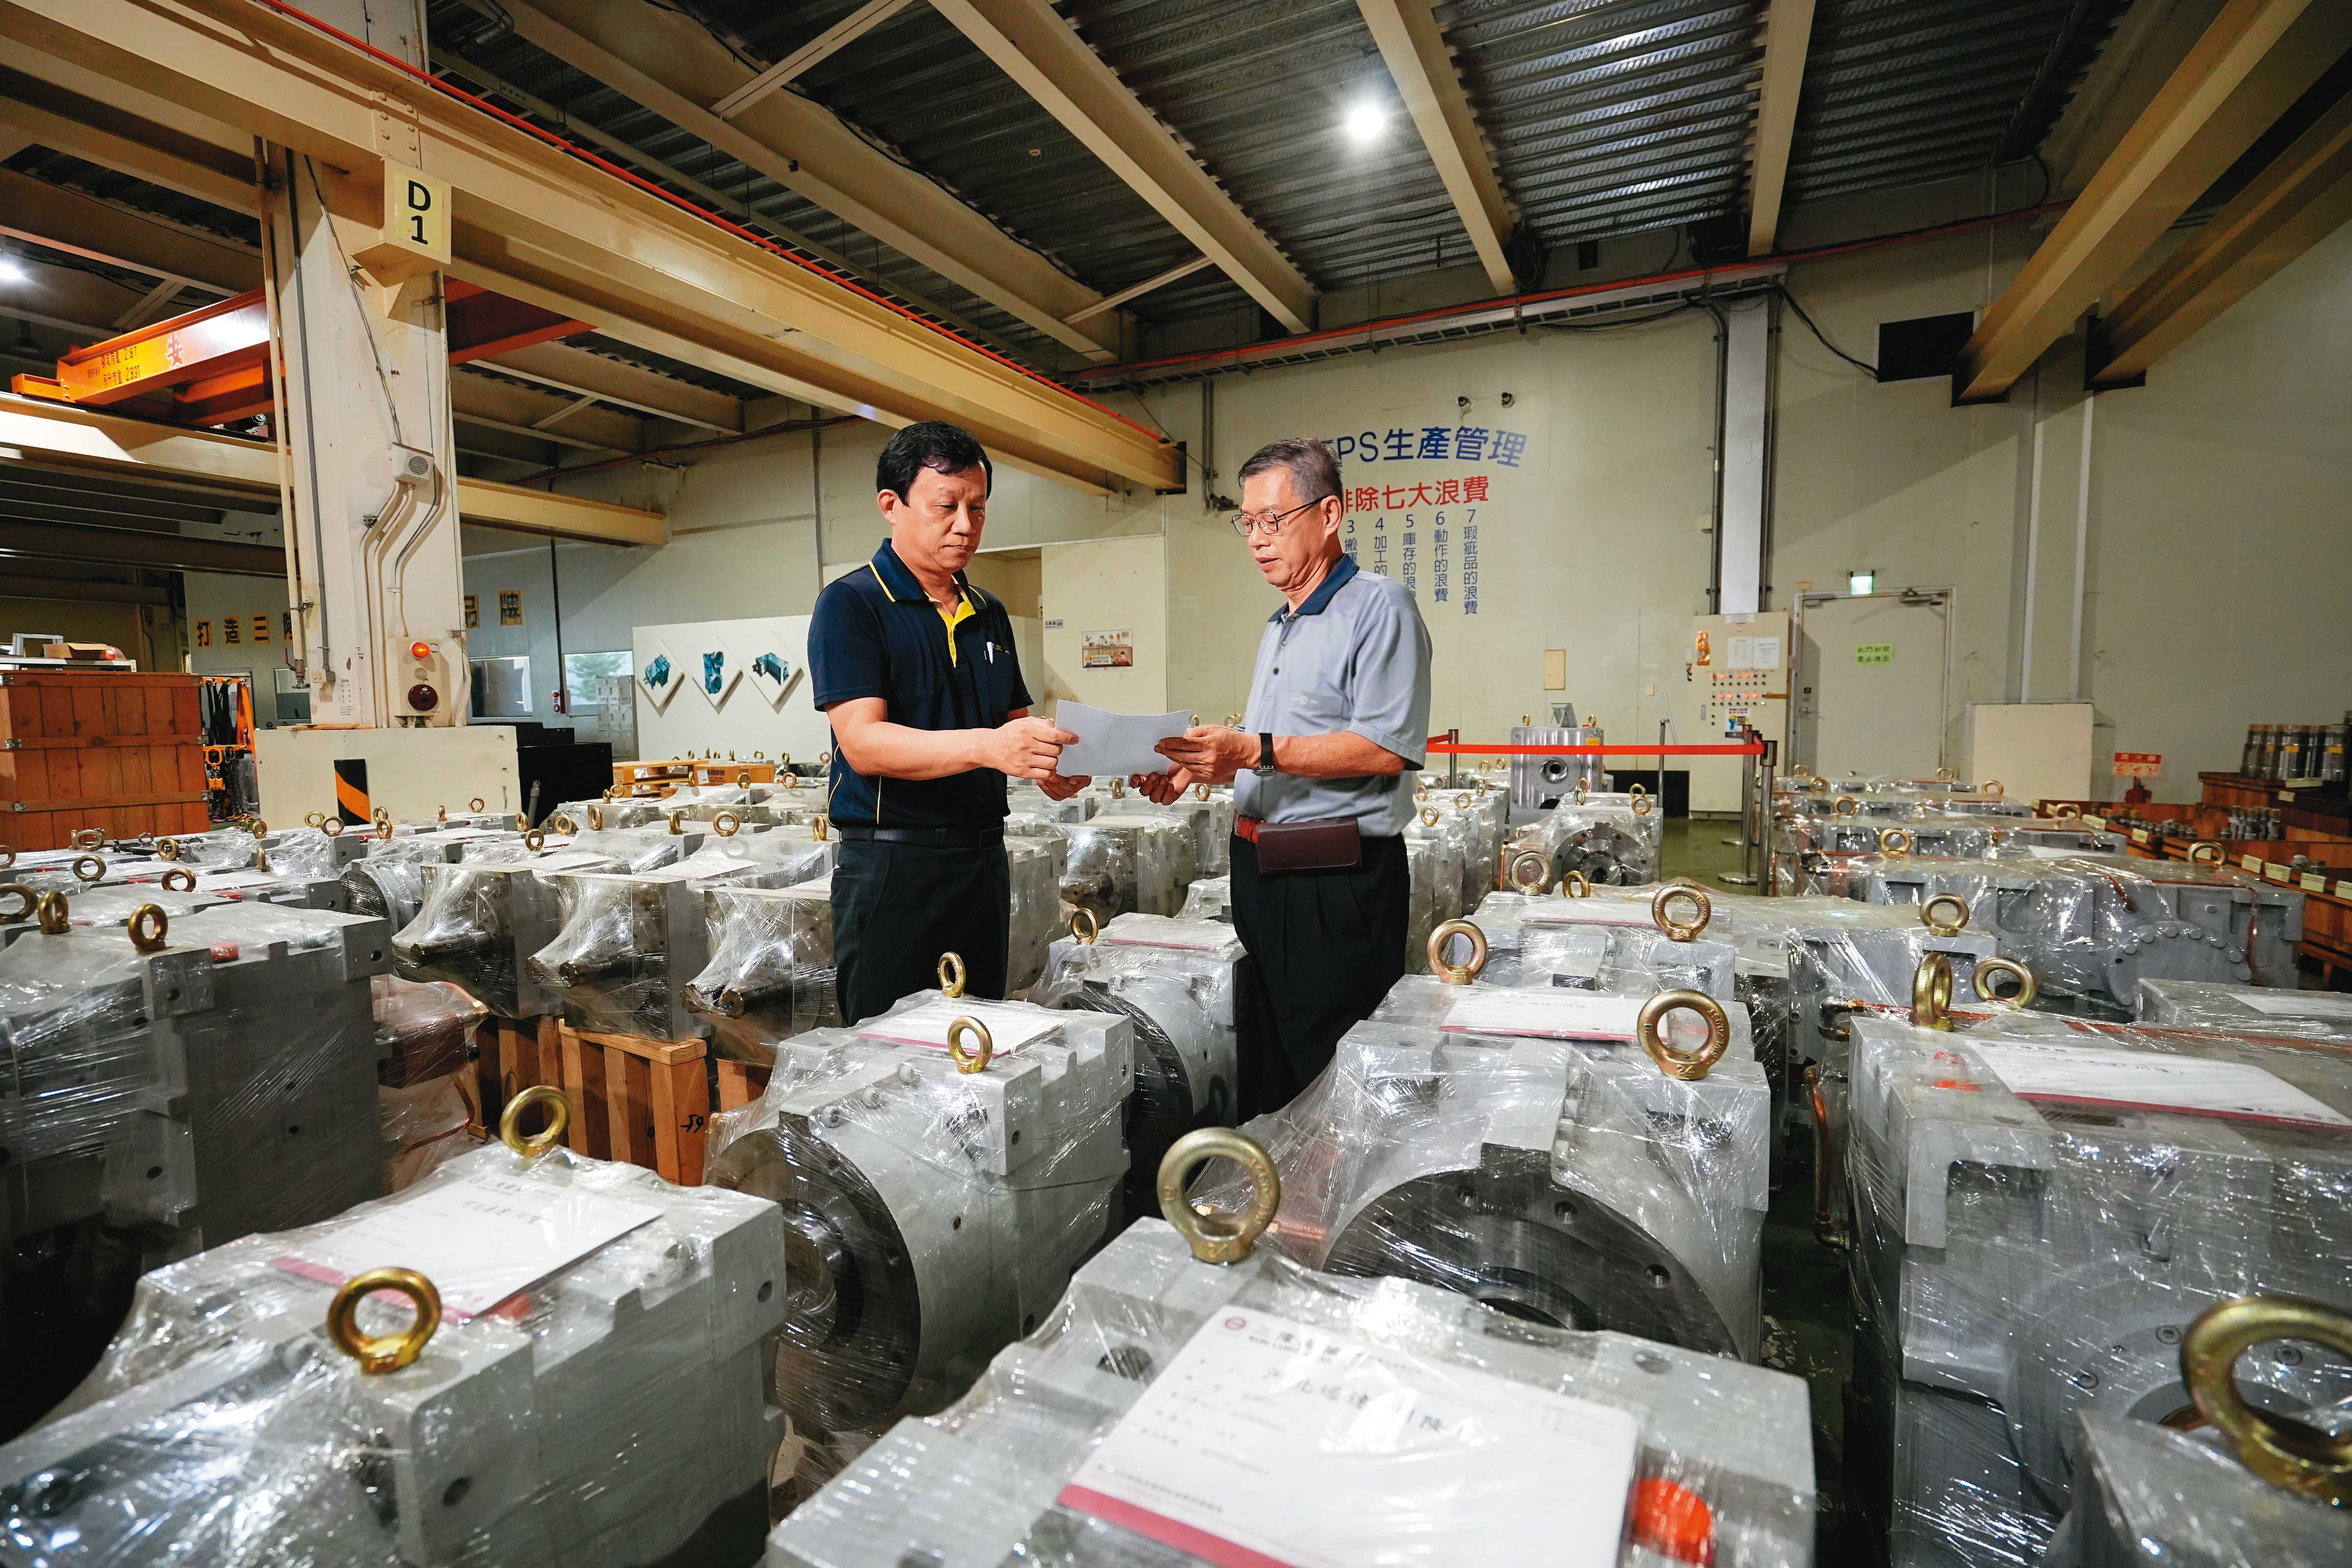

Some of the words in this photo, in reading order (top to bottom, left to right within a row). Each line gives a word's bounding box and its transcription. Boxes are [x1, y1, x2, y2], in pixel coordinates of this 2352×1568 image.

[408, 180, 431, 211] D
[411, 215, 428, 245] 1
[1321, 426, 1527, 467] PS生產管理
[1403, 532, 1416, 598] 庫存的浪
[1434, 529, 1448, 602] 動作的浪費
